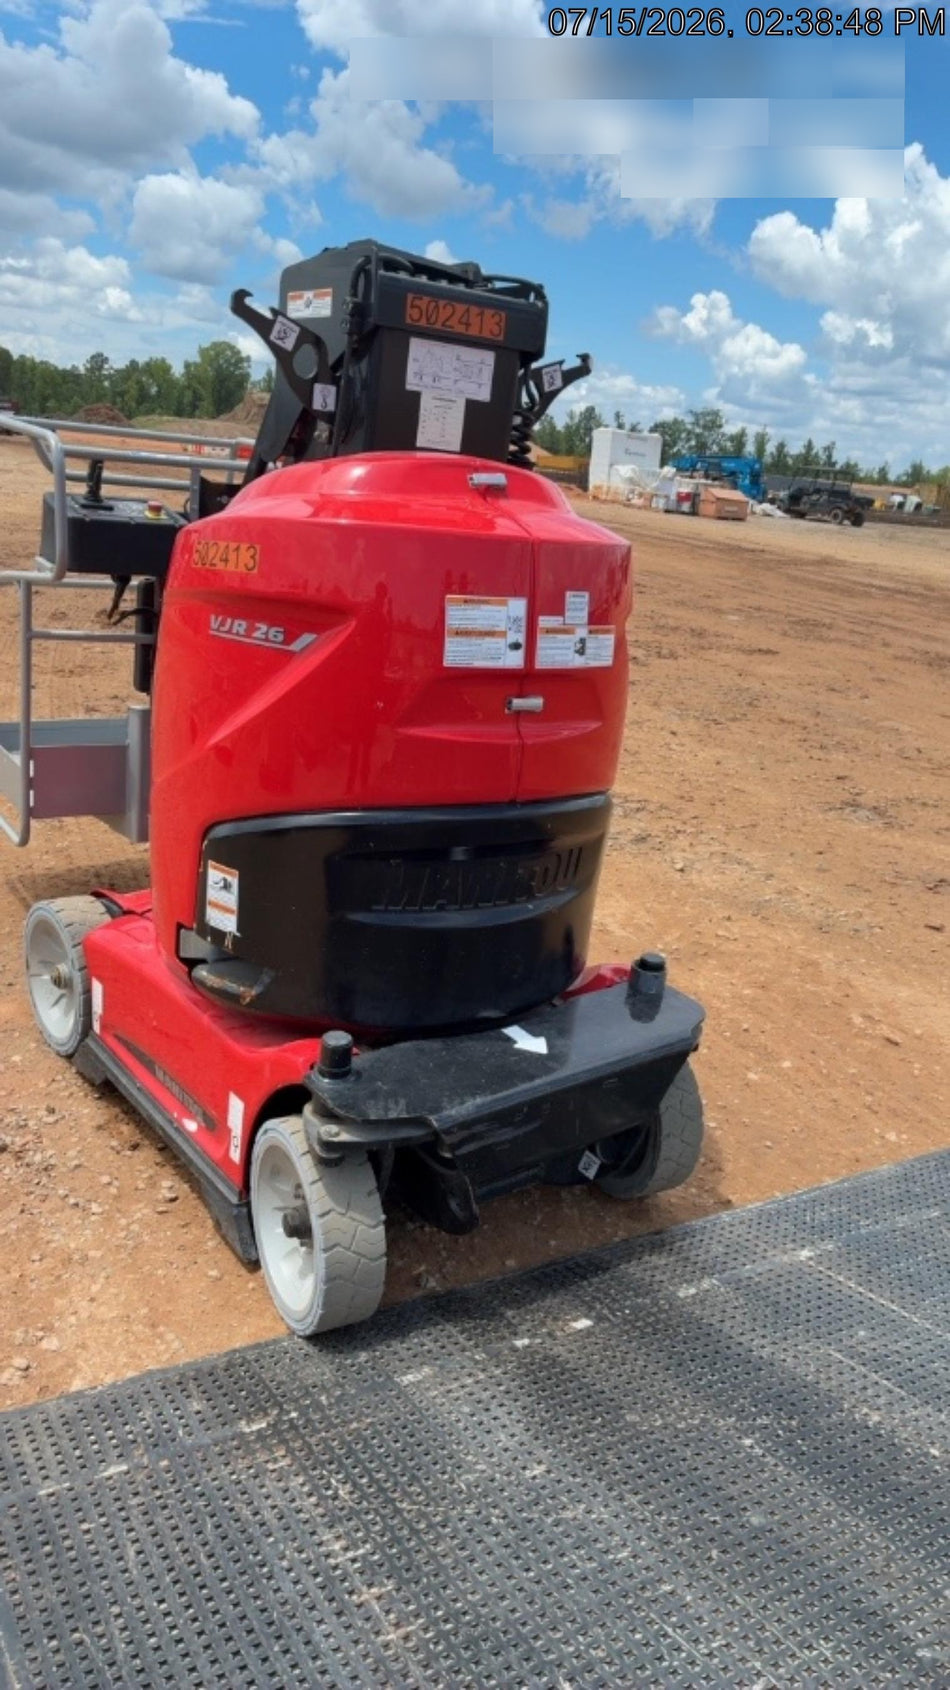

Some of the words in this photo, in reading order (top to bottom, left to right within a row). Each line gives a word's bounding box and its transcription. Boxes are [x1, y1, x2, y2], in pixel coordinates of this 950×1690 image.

[408, 296, 503, 338] 502413
[193, 541, 258, 571] 502413
[210, 614, 247, 636] VJR
[252, 623, 285, 643] 26
